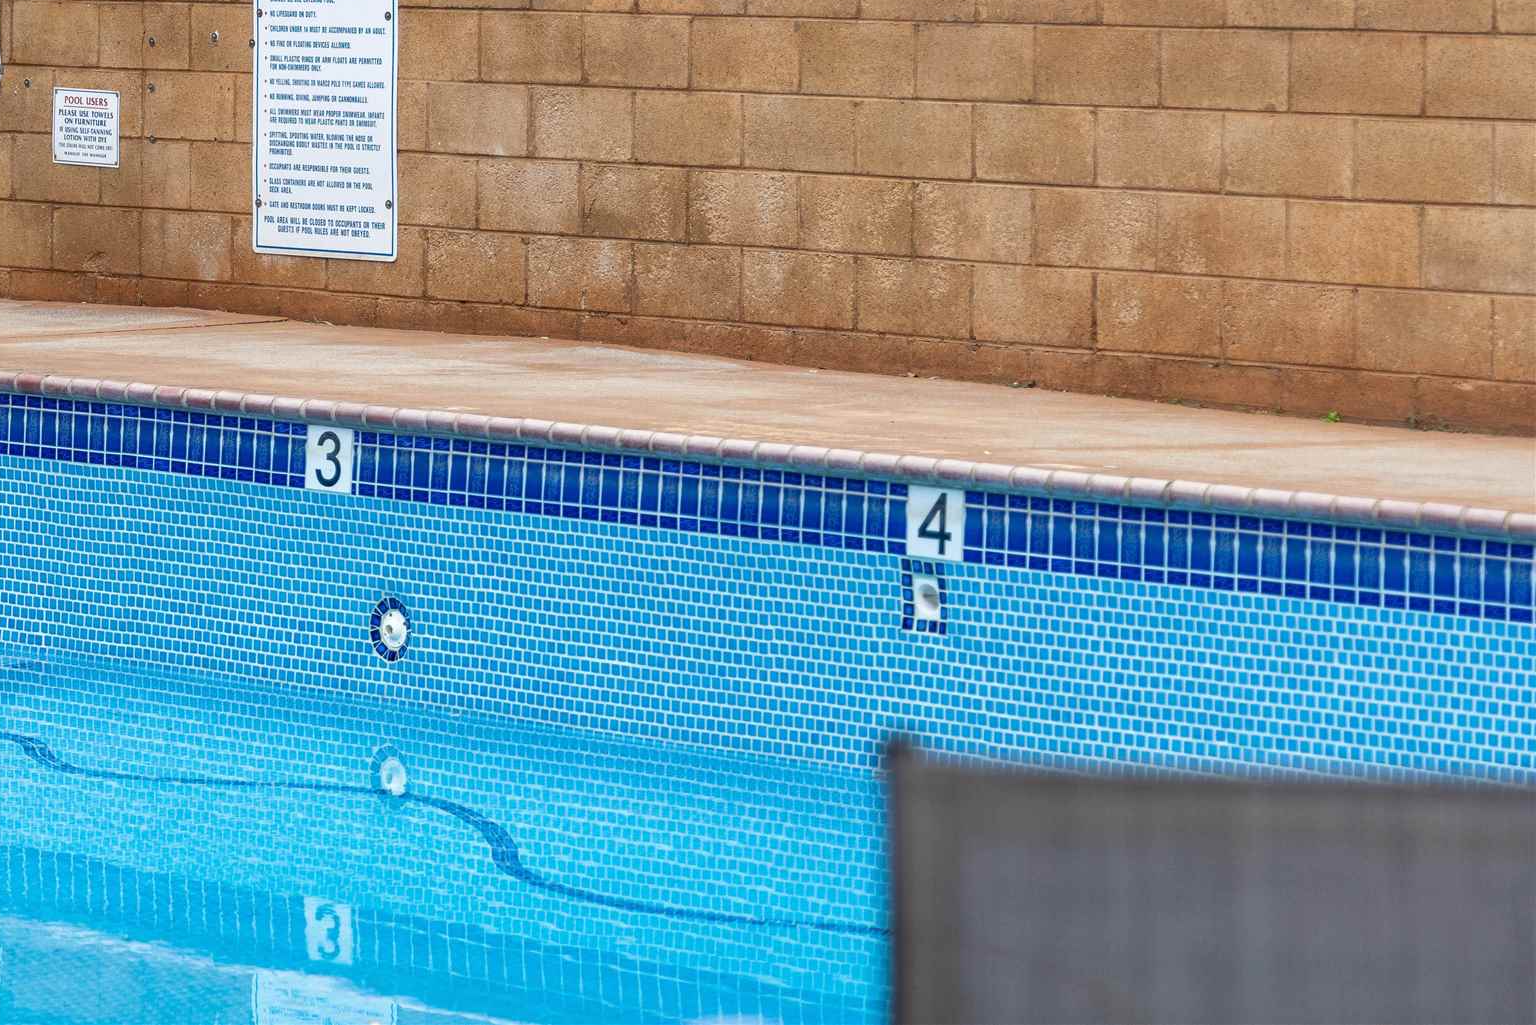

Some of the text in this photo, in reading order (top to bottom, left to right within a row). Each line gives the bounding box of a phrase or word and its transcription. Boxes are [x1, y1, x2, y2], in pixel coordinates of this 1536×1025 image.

[64, 96, 108, 106] POOL USERS
[59, 108, 77, 116] PLEASE
[92, 110, 114, 119] TOWELS
[75, 118, 106, 126] FURNITURE
[316, 431, 341, 487] 3
[918, 492, 952, 555] 4
